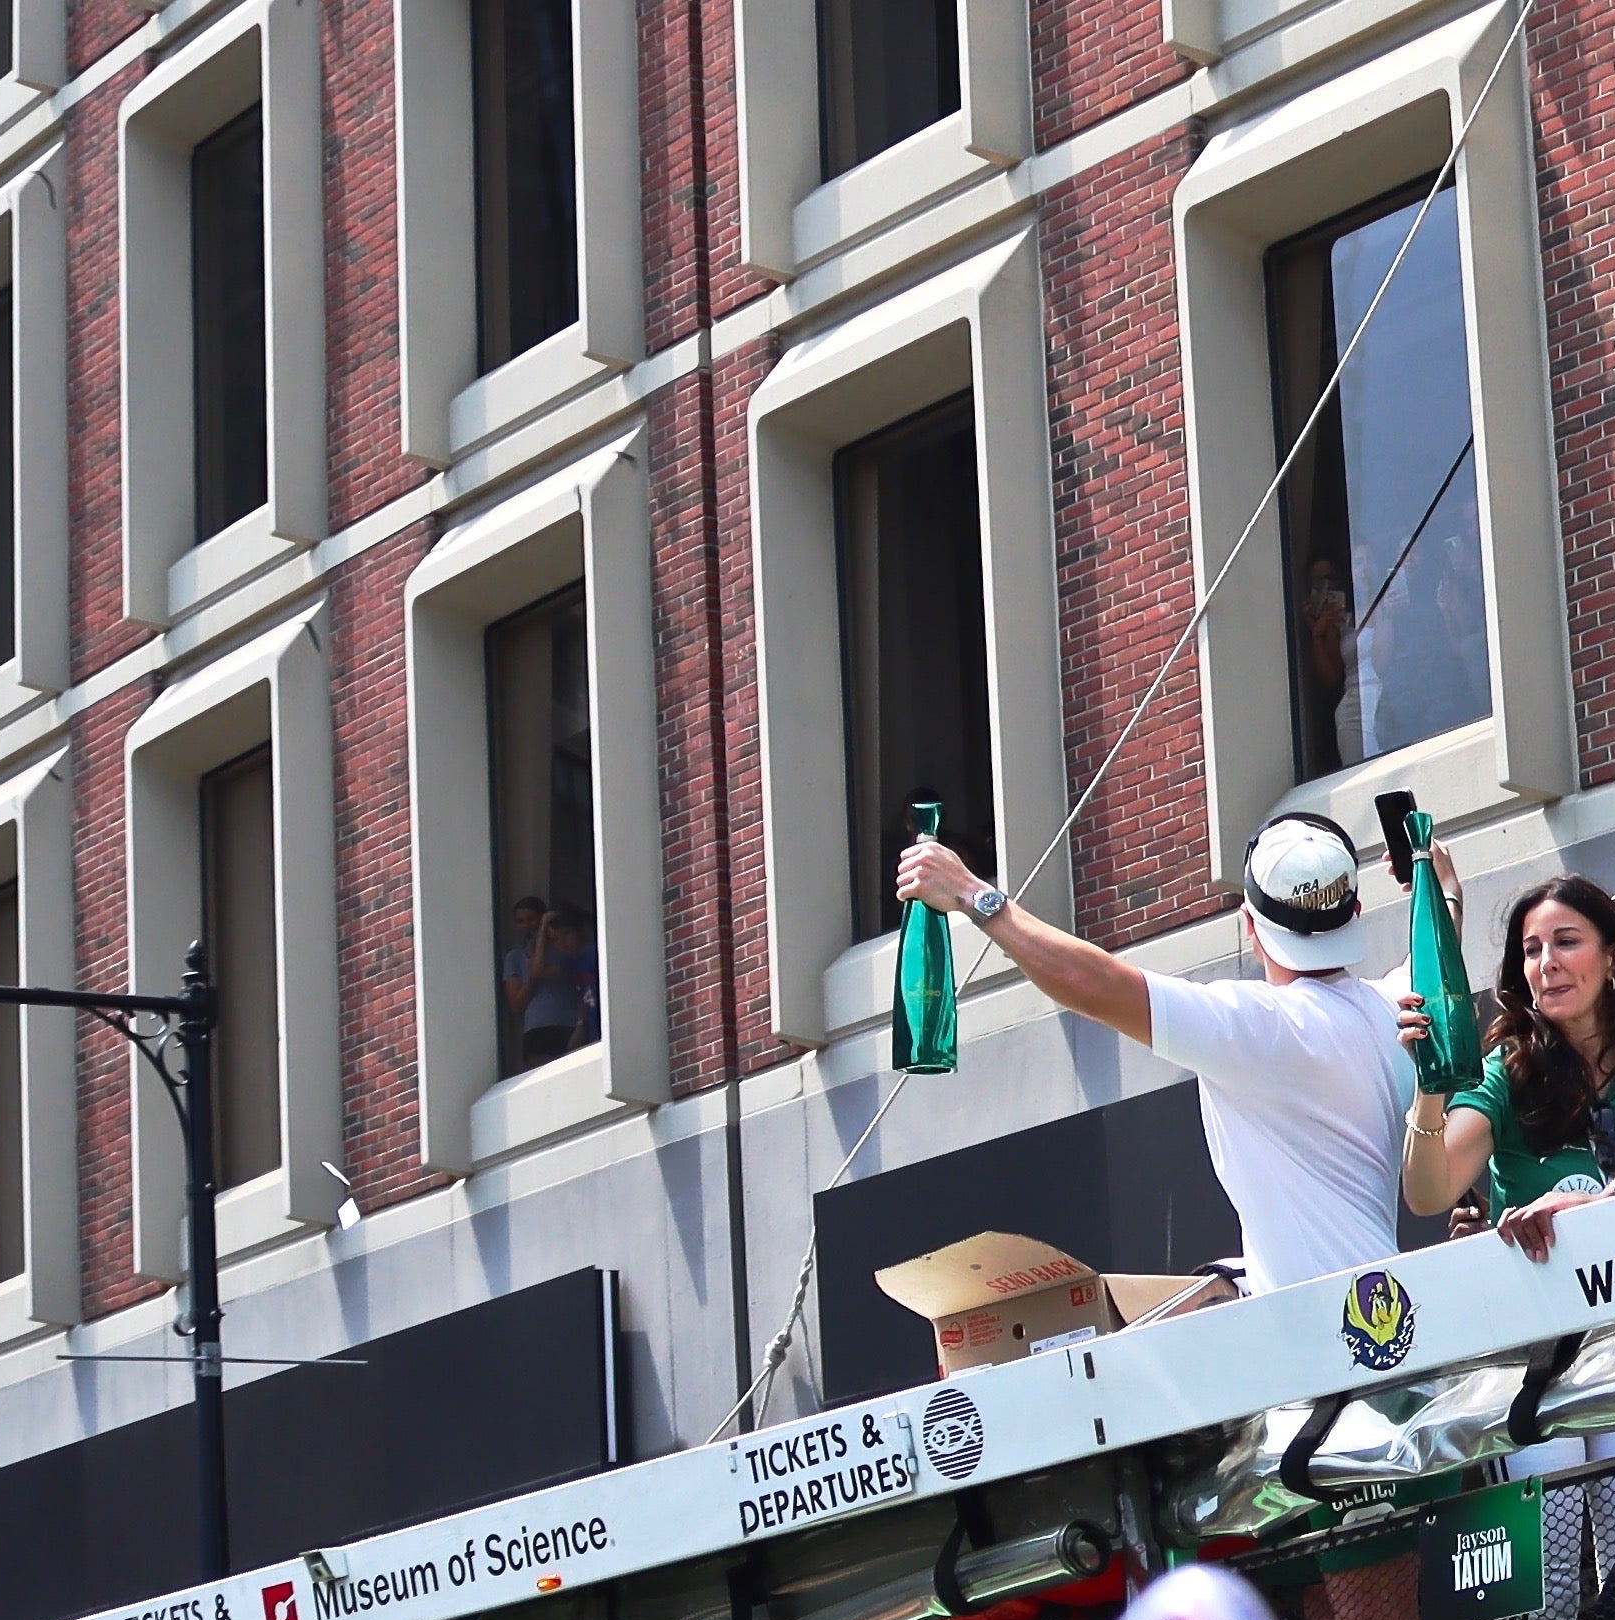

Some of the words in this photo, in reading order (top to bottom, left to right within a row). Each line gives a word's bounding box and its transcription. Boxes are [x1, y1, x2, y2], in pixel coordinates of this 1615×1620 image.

[1291, 878, 1319, 896] NBA
[985, 1270, 1034, 1295] SEND
[1033, 1257, 1081, 1285] BACK
[746, 1423, 847, 1484] TICKETS
[860, 1413, 884, 1449] &
[739, 1453, 908, 1538] DEPARTURES
[1456, 1525, 1507, 1553] Jayson
[313, 1562, 438, 1620] Museum
[448, 1540, 477, 1587] of
[485, 1516, 608, 1576] Science
[1451, 1540, 1513, 1592] TATUM
